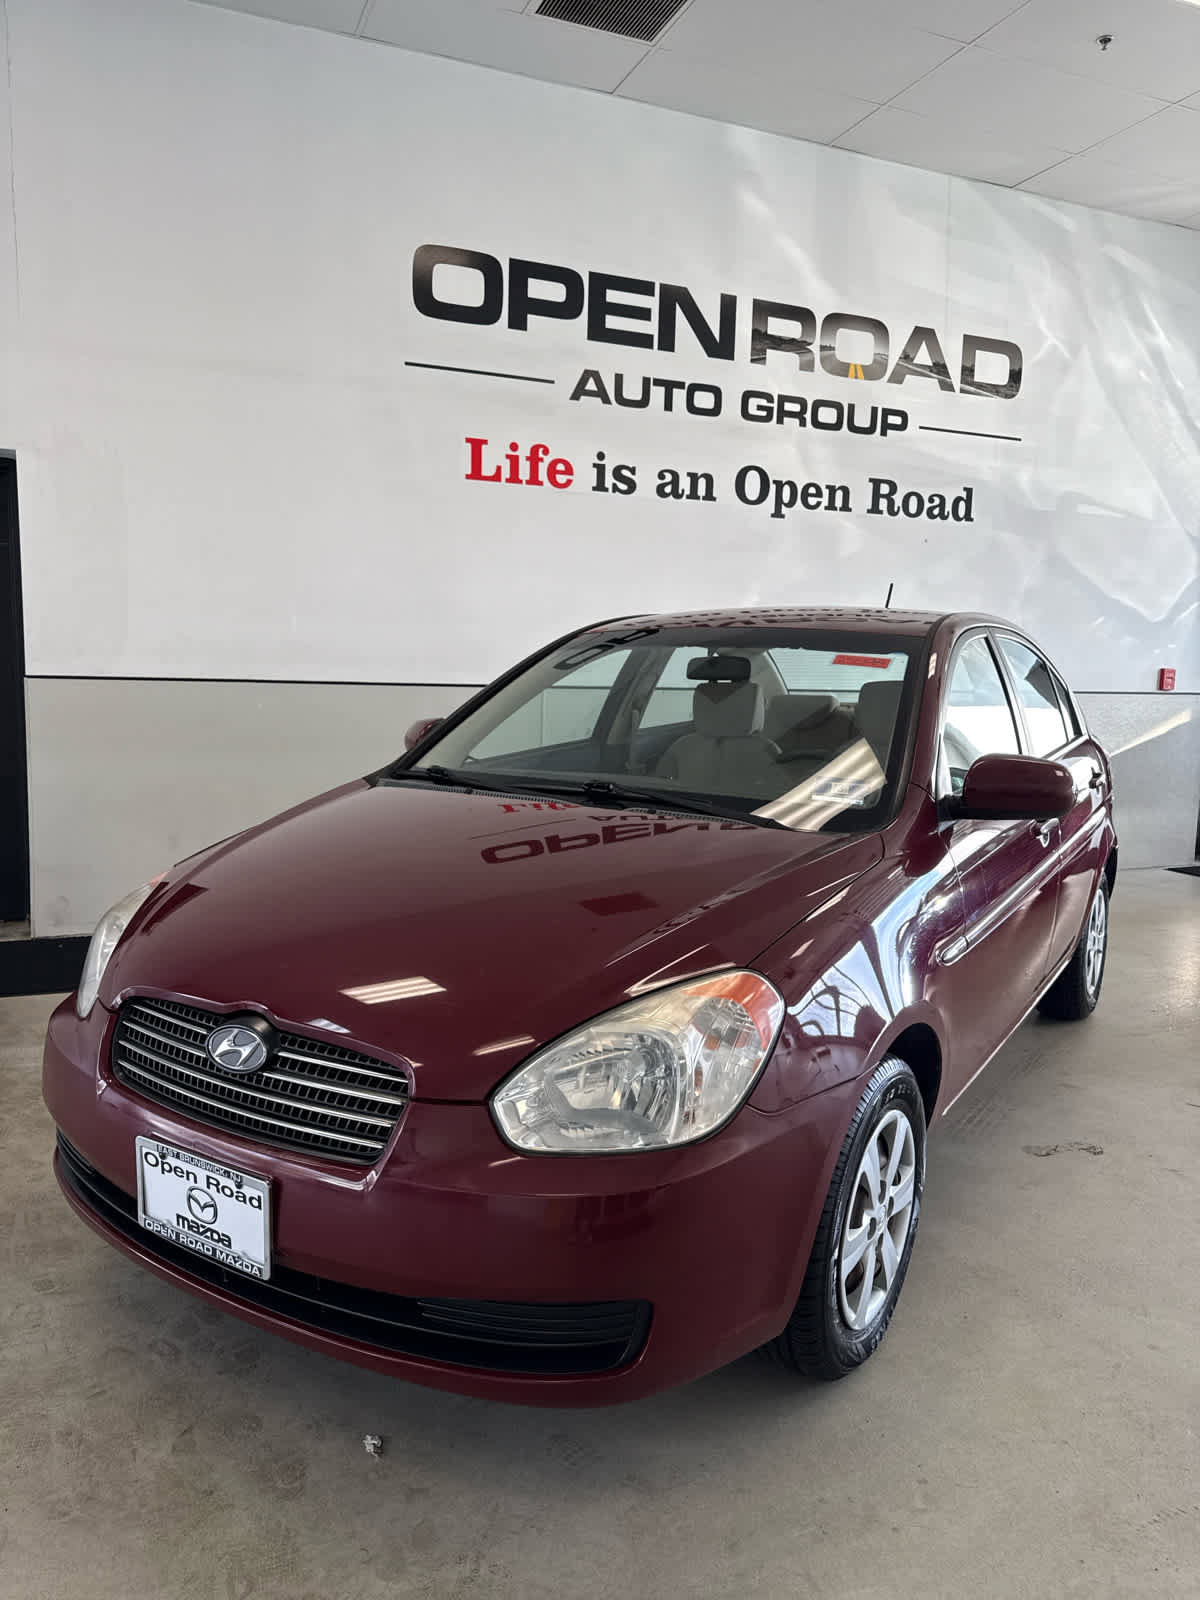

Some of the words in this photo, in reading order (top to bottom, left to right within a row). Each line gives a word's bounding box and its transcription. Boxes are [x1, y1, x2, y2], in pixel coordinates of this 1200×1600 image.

[411, 243, 738, 362] OPEN
[749, 297, 1024, 400] ROAD
[568, 368, 723, 418] AUTO
[740, 389, 909, 438] GROUP
[464, 436, 575, 490] Life
[591, 450, 638, 496] is
[655, 468, 718, 503] an
[734, 464, 853, 519] Open
[865, 476, 975, 523] Road
[144, 1151, 198, 1184] Open
[206, 1175, 262, 1211] Road
[145, 1219, 176, 1241] OPEN
[179, 1233, 213, 1256] ROAD
[216, 1248, 260, 1277] MAZDA
